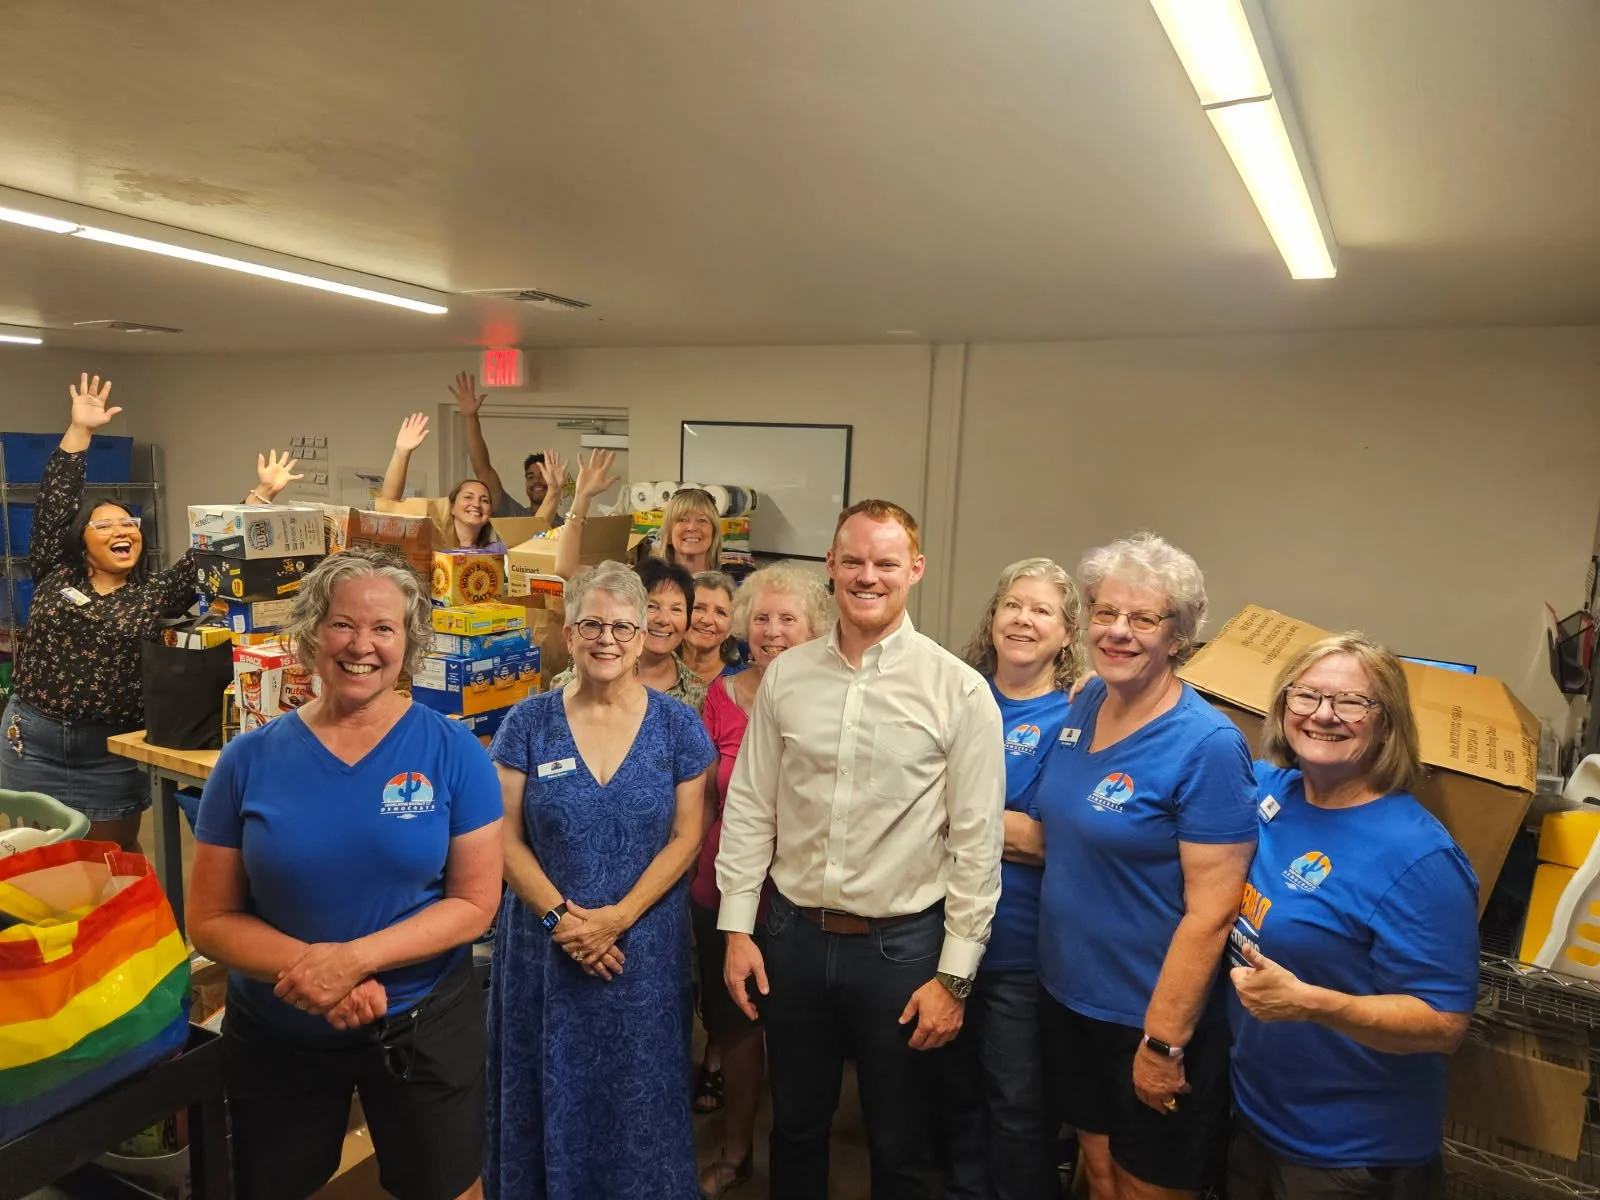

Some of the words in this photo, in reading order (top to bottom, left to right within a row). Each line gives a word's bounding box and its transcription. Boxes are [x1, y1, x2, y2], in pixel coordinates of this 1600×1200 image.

[485, 350, 518, 385] EXIT
[511, 564, 540, 574] Cuisinart
[462, 565, 476, 589] HONEY
[475, 563, 496, 587] BUNCHES
[473, 591, 492, 602] OATS
[285, 685, 306, 696] nute
